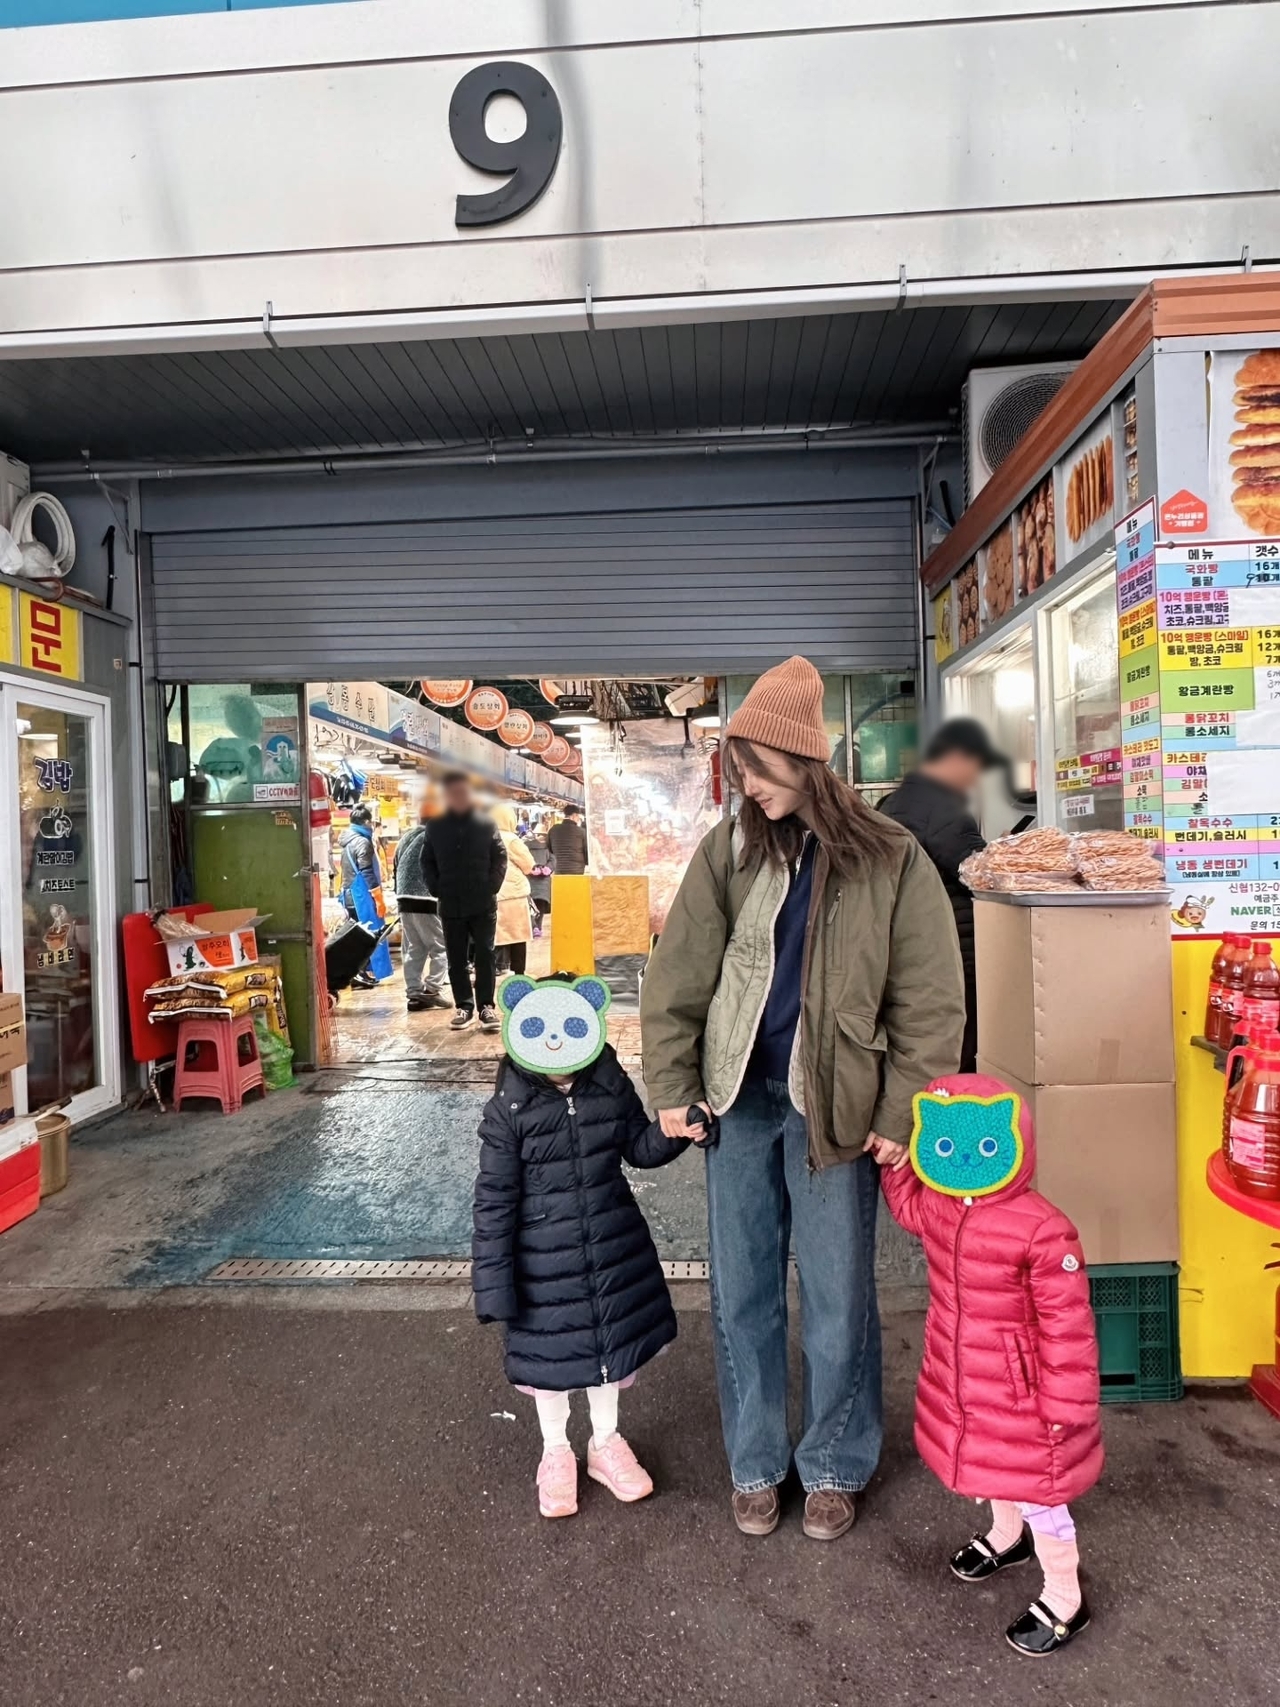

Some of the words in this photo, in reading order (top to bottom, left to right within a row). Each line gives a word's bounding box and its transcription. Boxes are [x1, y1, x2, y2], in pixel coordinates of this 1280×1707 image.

[448, 60, 563, 229] 9
[1255, 545, 1279, 557] 갯수
[1185, 563, 1218, 575] 국화빵
[1160, 592, 1181, 602] 10억
[1184, 591, 1211, 602] 행운빵
[1161, 632, 1183, 643] 10억
[1185, 631, 1212, 642] 행운빵
[1203, 656, 1221, 666] 초코
[1178, 685, 1234, 696] 황금계란빵
[34, 754, 74, 794] 김밥
[1188, 818, 1232, 829] 찰옥수수
[1175, 830, 1247, 842] 번데기,슬러시
[1175, 859, 1197, 871] 냉동
[1203, 858, 1248, 870] 생번데기
[1230, 906, 1272, 916] NAVER
[1250, 920, 1268, 930] 문의
